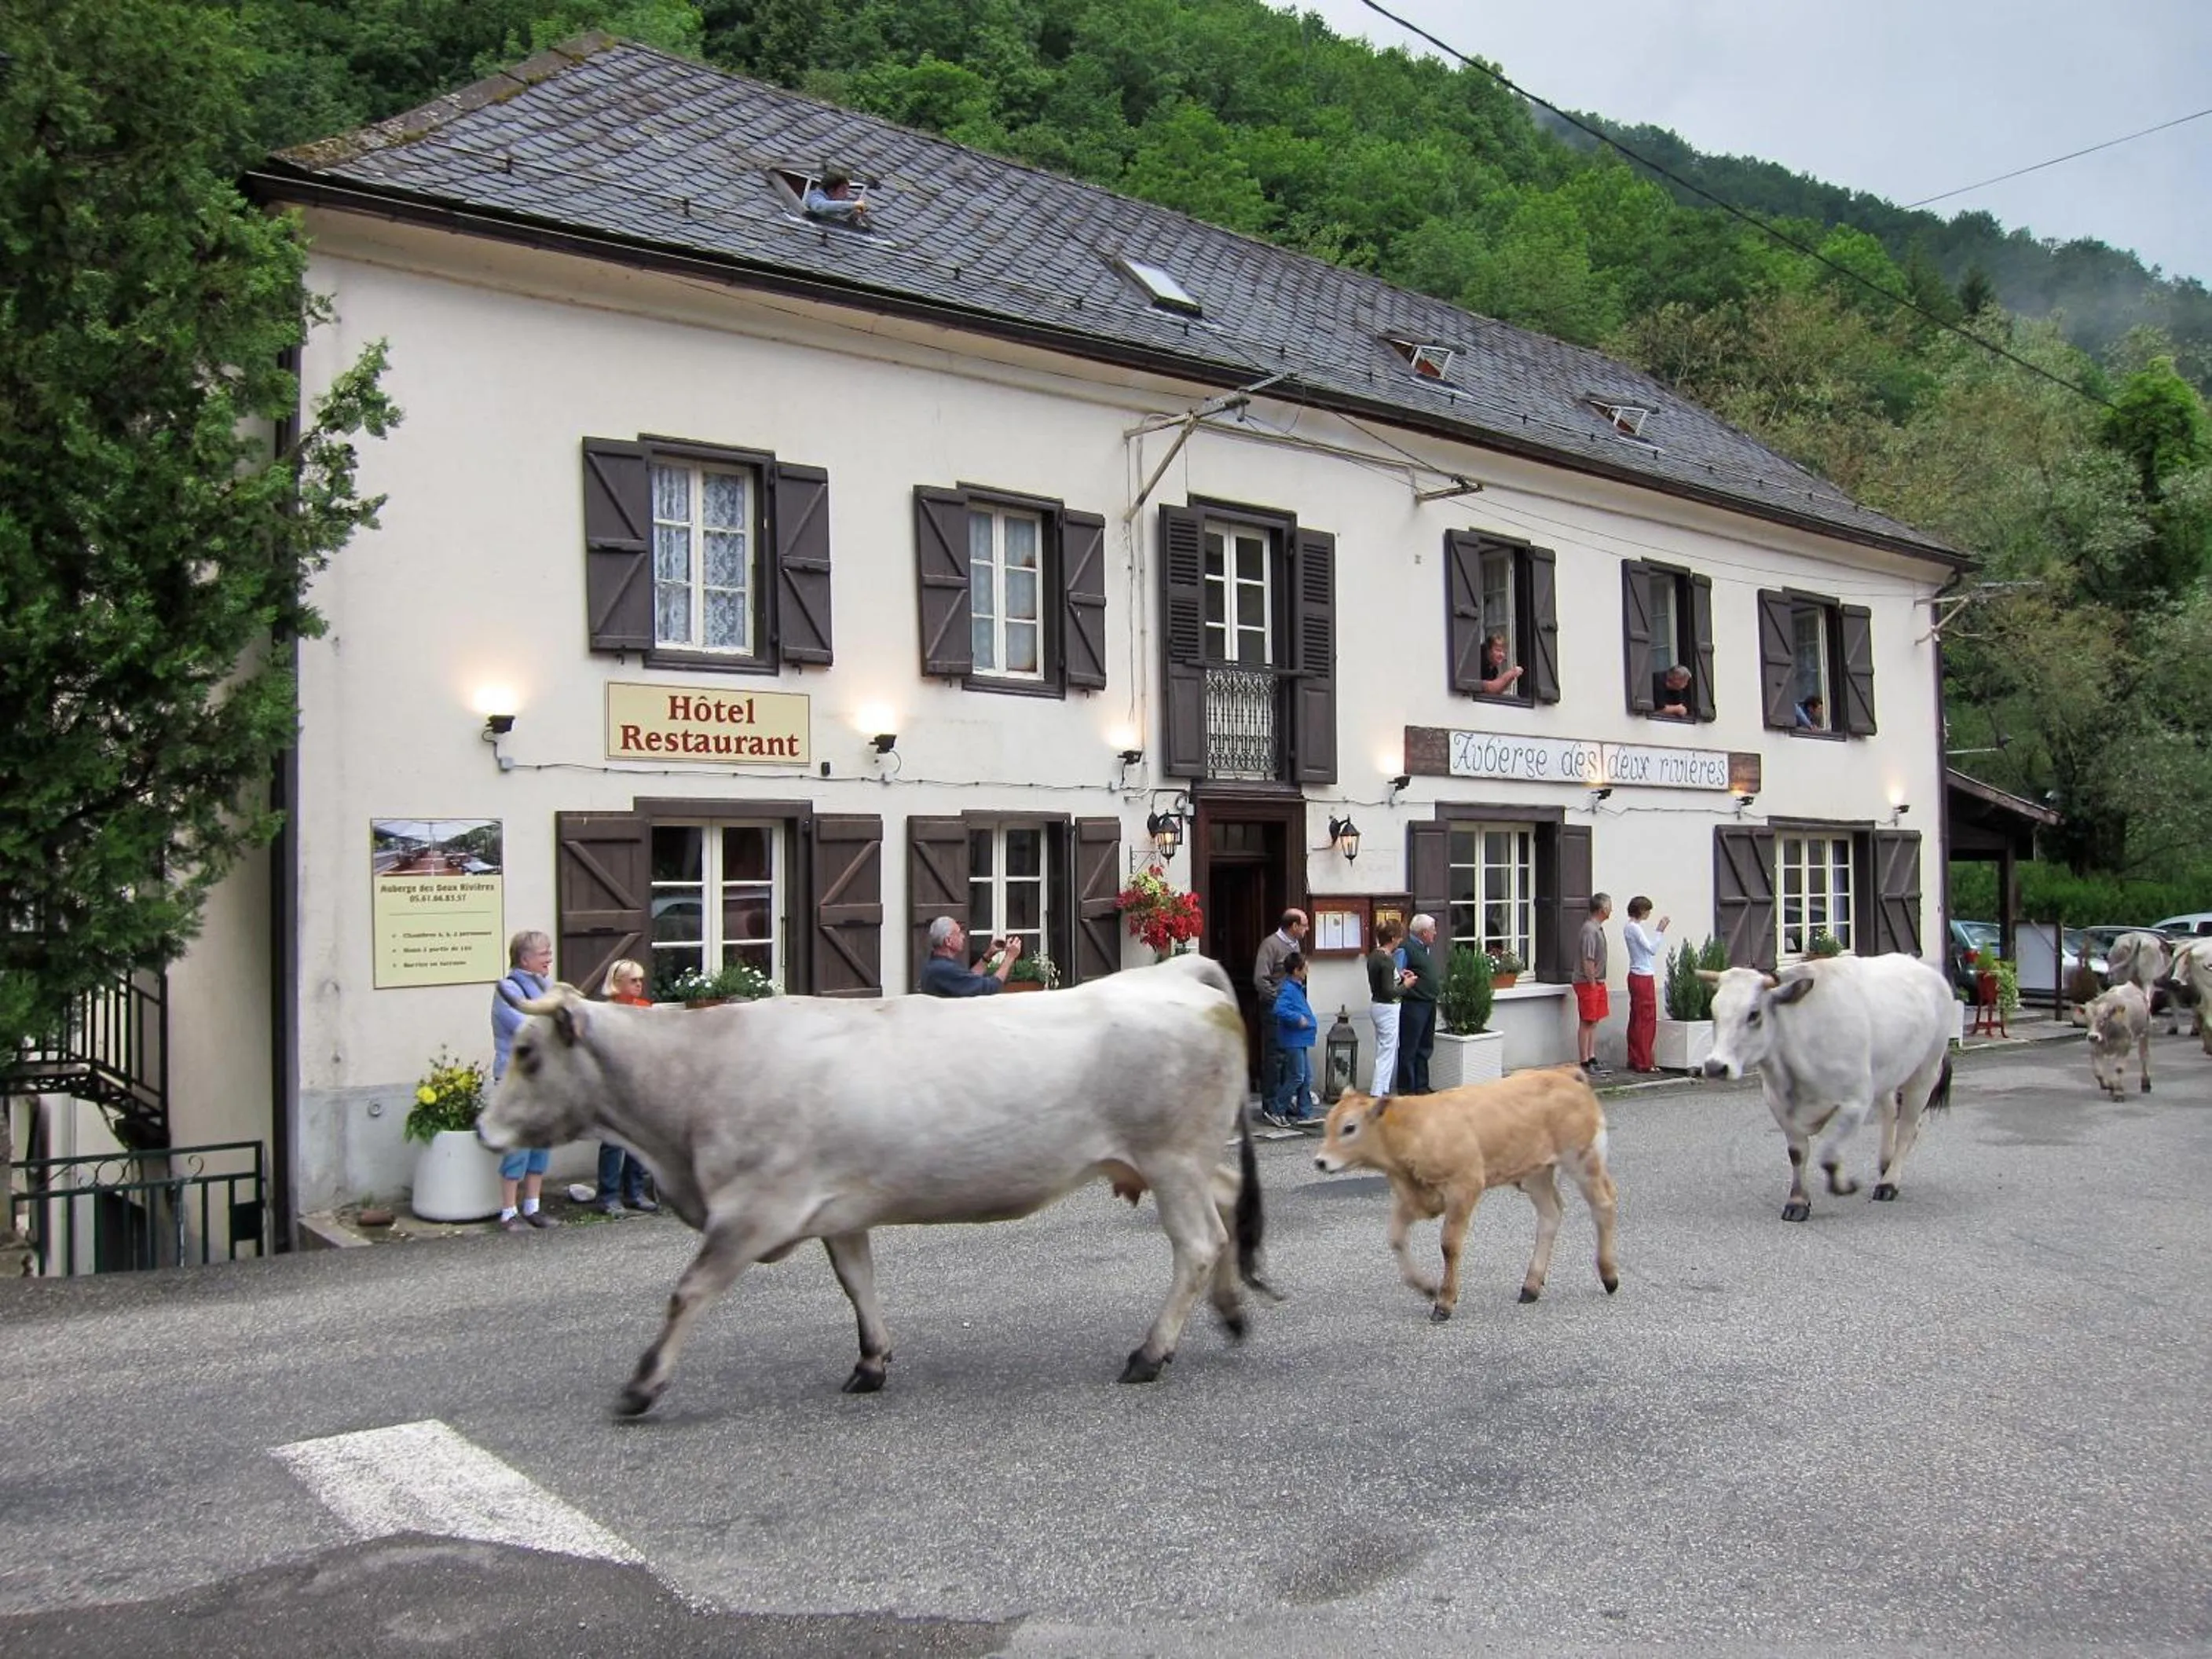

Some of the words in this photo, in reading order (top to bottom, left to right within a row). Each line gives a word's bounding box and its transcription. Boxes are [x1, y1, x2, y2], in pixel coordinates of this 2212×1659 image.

[668, 695, 756, 724] Hôtel
[621, 724, 800, 757] Restaurant
[1453, 732, 1547, 778] Auberge
[1562, 742, 1597, 779] des
[1608, 746, 1650, 781] deux
[380, 884, 417, 894] Auberge
[419, 884, 434, 892] des
